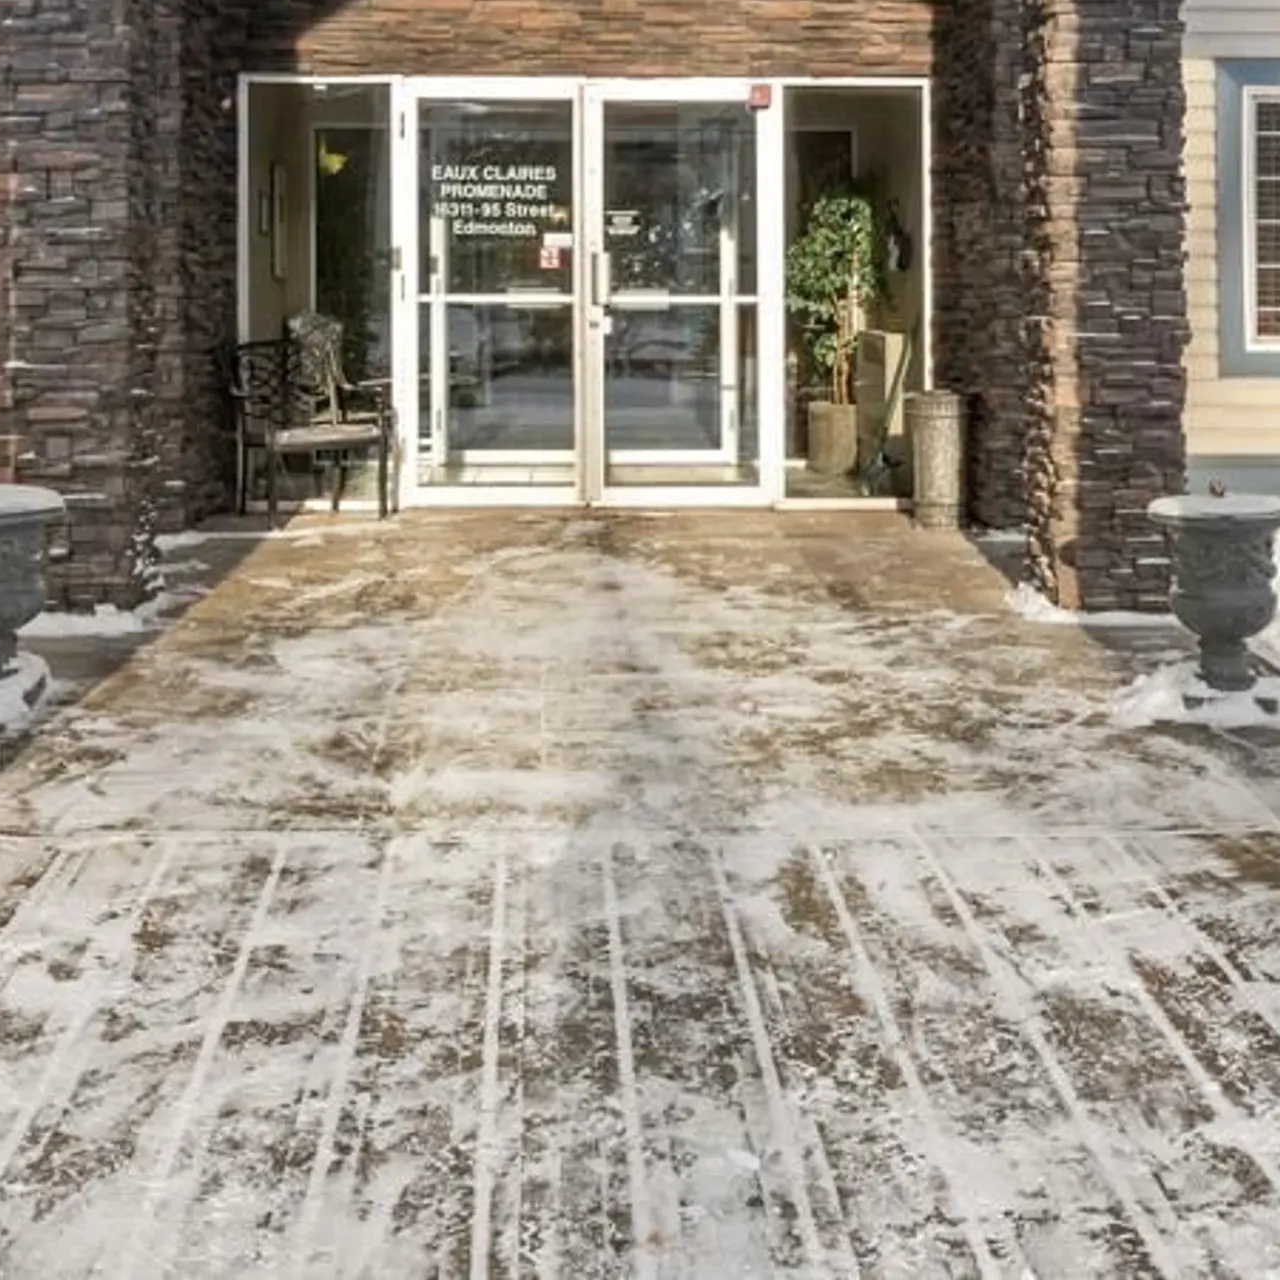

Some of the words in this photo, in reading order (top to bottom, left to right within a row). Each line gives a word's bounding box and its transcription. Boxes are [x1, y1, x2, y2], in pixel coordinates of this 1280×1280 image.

[432, 164, 479, 180] EAUX
[483, 164, 557, 180] CLAIRES
[440, 184, 548, 200] PROMENADE
[504, 201, 556, 218] Street
[452, 220, 537, 236] Edmonton
